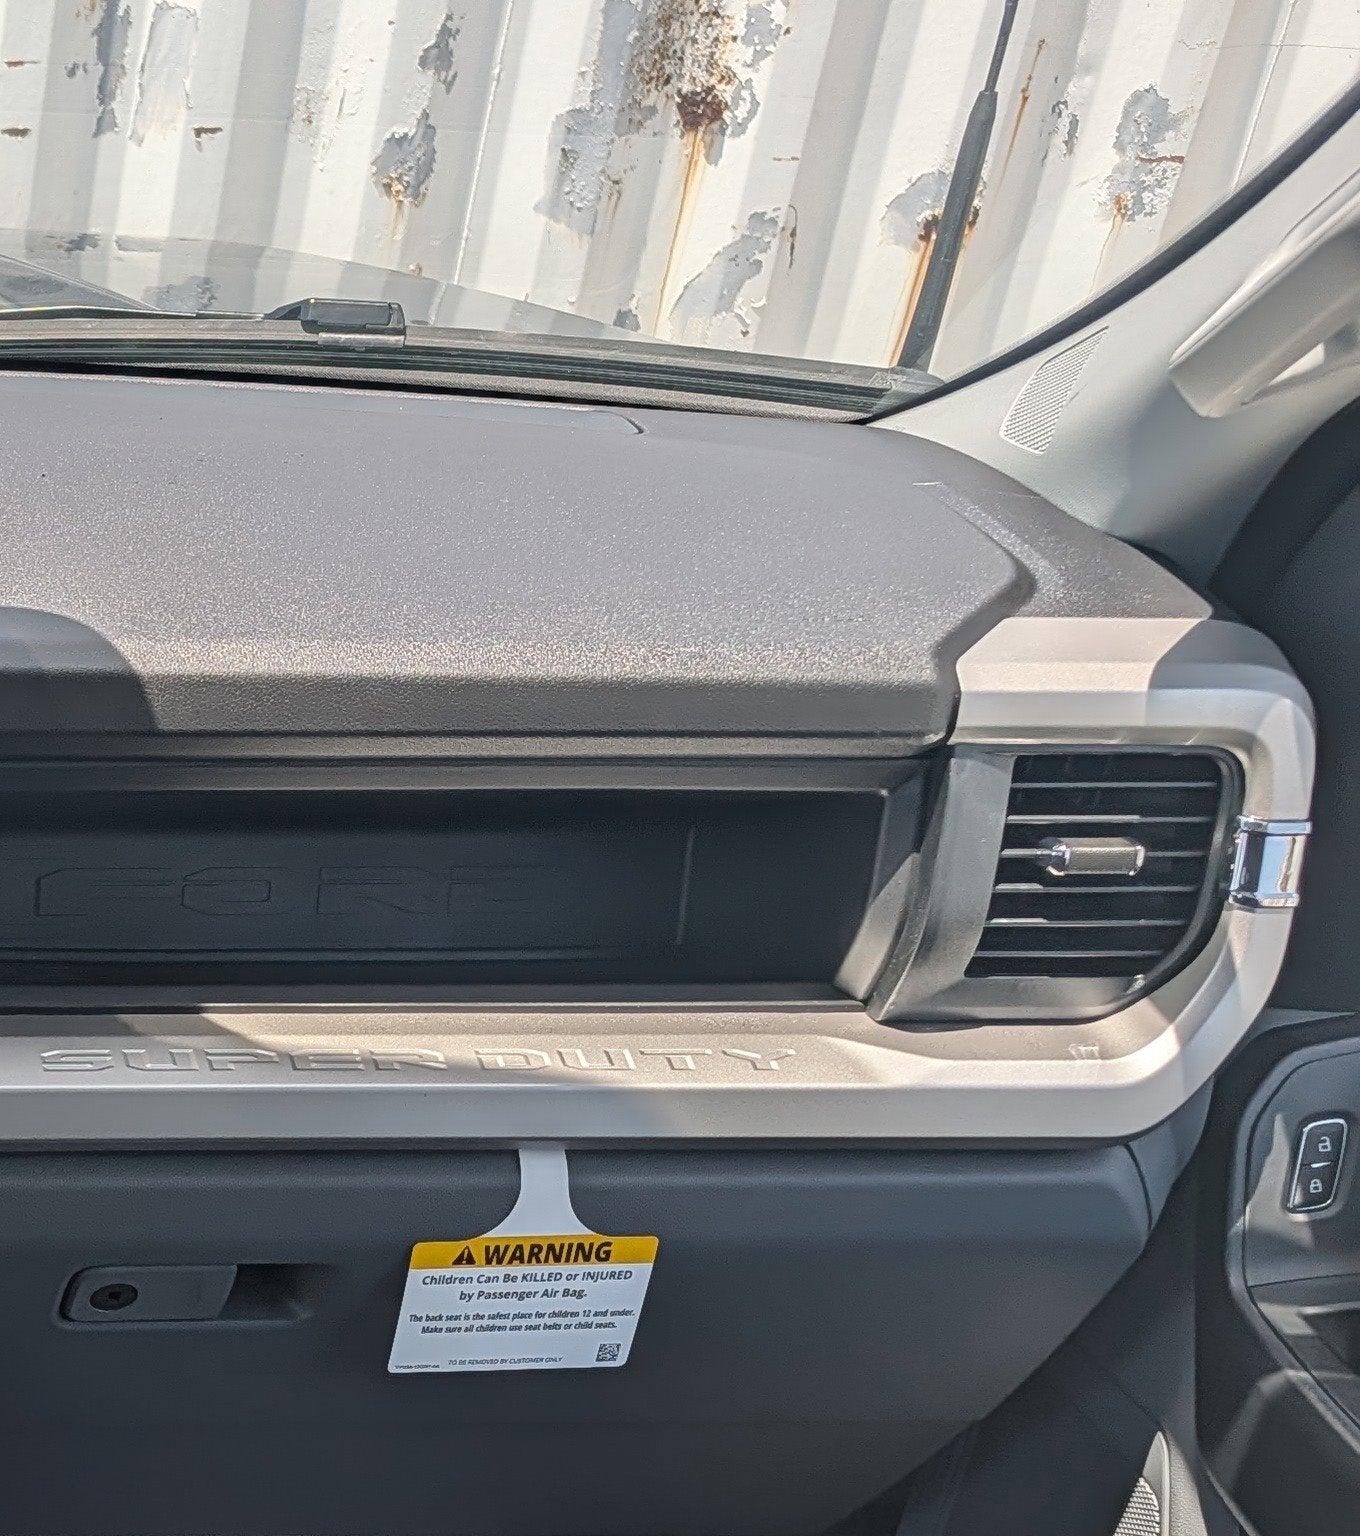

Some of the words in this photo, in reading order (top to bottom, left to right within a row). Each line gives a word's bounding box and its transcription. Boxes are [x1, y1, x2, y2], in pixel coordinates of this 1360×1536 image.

[41, 1049, 447, 1072] SUPER
[474, 1048, 796, 1072] DUTY
[484, 1242, 613, 1266] WARNING
[422, 1274, 474, 1286] Children
[477, 1274, 500, 1284] Can
[503, 1274, 518, 1282] Be
[521, 1272, 562, 1282] KILLED
[566, 1272, 579, 1282] or
[582, 1270, 633, 1282] INJURED
[460, 1291, 475, 1302] by
[477, 1290, 538, 1301] Passenger
[540, 1288, 559, 1299] Air
[562, 1288, 588, 1300] Bag.
[410, 1314, 422, 1322] The
[425, 1314, 444, 1322] back
[446, 1314, 462, 1322] seat
[472, 1312, 486, 1320] the
[488, 1312, 510, 1320] safest
[512, 1311, 533, 1322] place
[534, 1310, 546, 1319] for
[548, 1310, 580, 1318] children
[582, 1310, 590, 1318] 12
[592, 1309, 608, 1318] and
[610, 1308, 636, 1317] under.
[421, 1326, 443, 1334] Make
[464, 1325, 474, 1333] all
[476, 1324, 507, 1333] children
[524, 1323, 541, 1332] seat
[542, 1322, 562, 1331] belts
[574, 1322, 593, 1330] child
[594, 1322, 618, 1330] seats.
